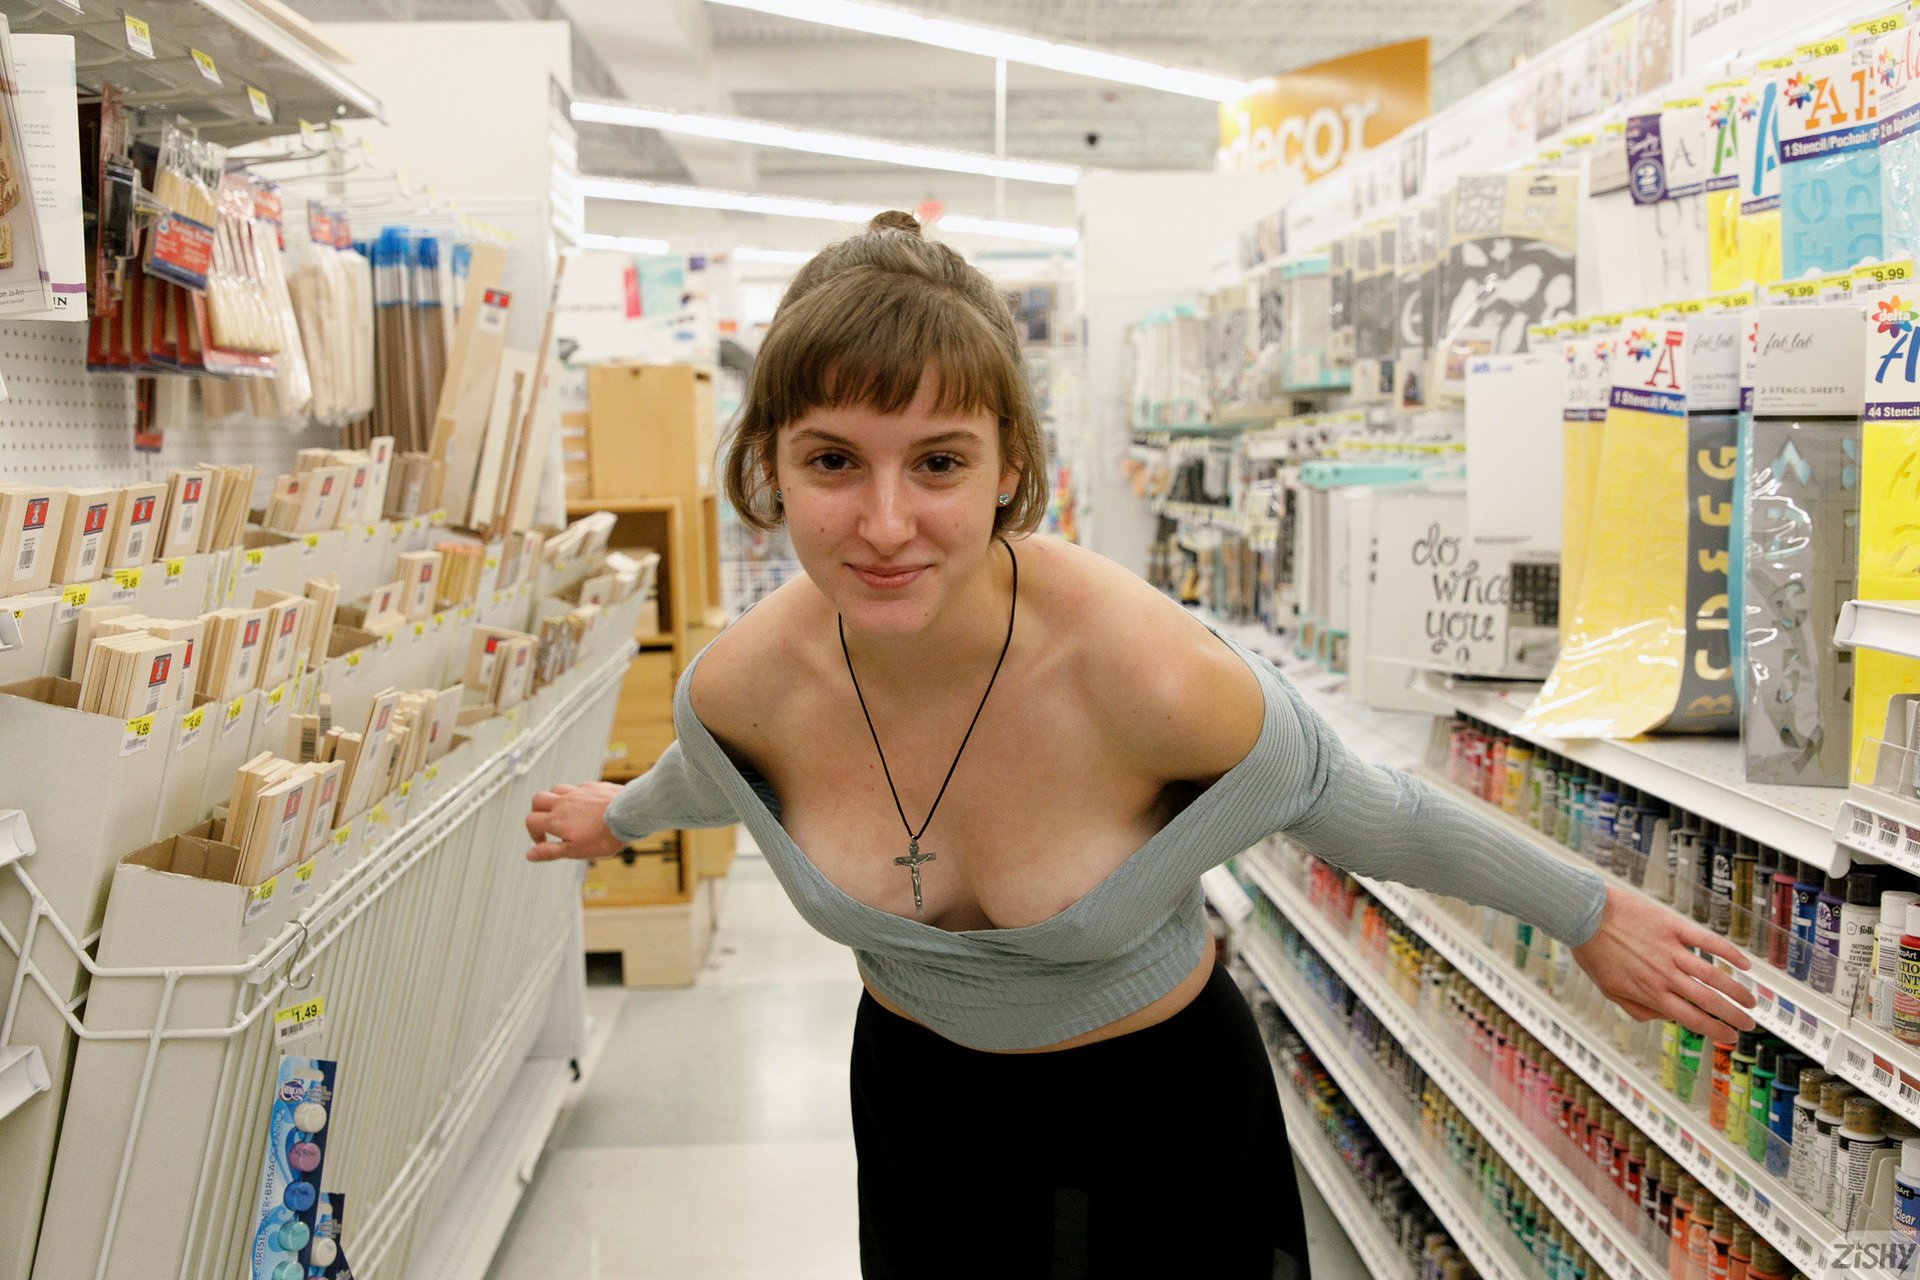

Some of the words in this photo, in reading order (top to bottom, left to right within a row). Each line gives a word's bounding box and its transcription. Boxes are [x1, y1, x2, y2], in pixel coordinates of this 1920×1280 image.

[1230, 99, 1381, 173] decor
[1872, 267, 1905, 282] $9.99
[1878, 309, 1911, 322] delta
[1810, 386, 1846, 394] SHEETS
[1868, 407, 1882, 417] 44
[1883, 405, 1920, 417] Stencil
[1411, 521, 1461, 567] do
[1432, 560, 1511, 605] wha
[1425, 610, 1496, 653] you
